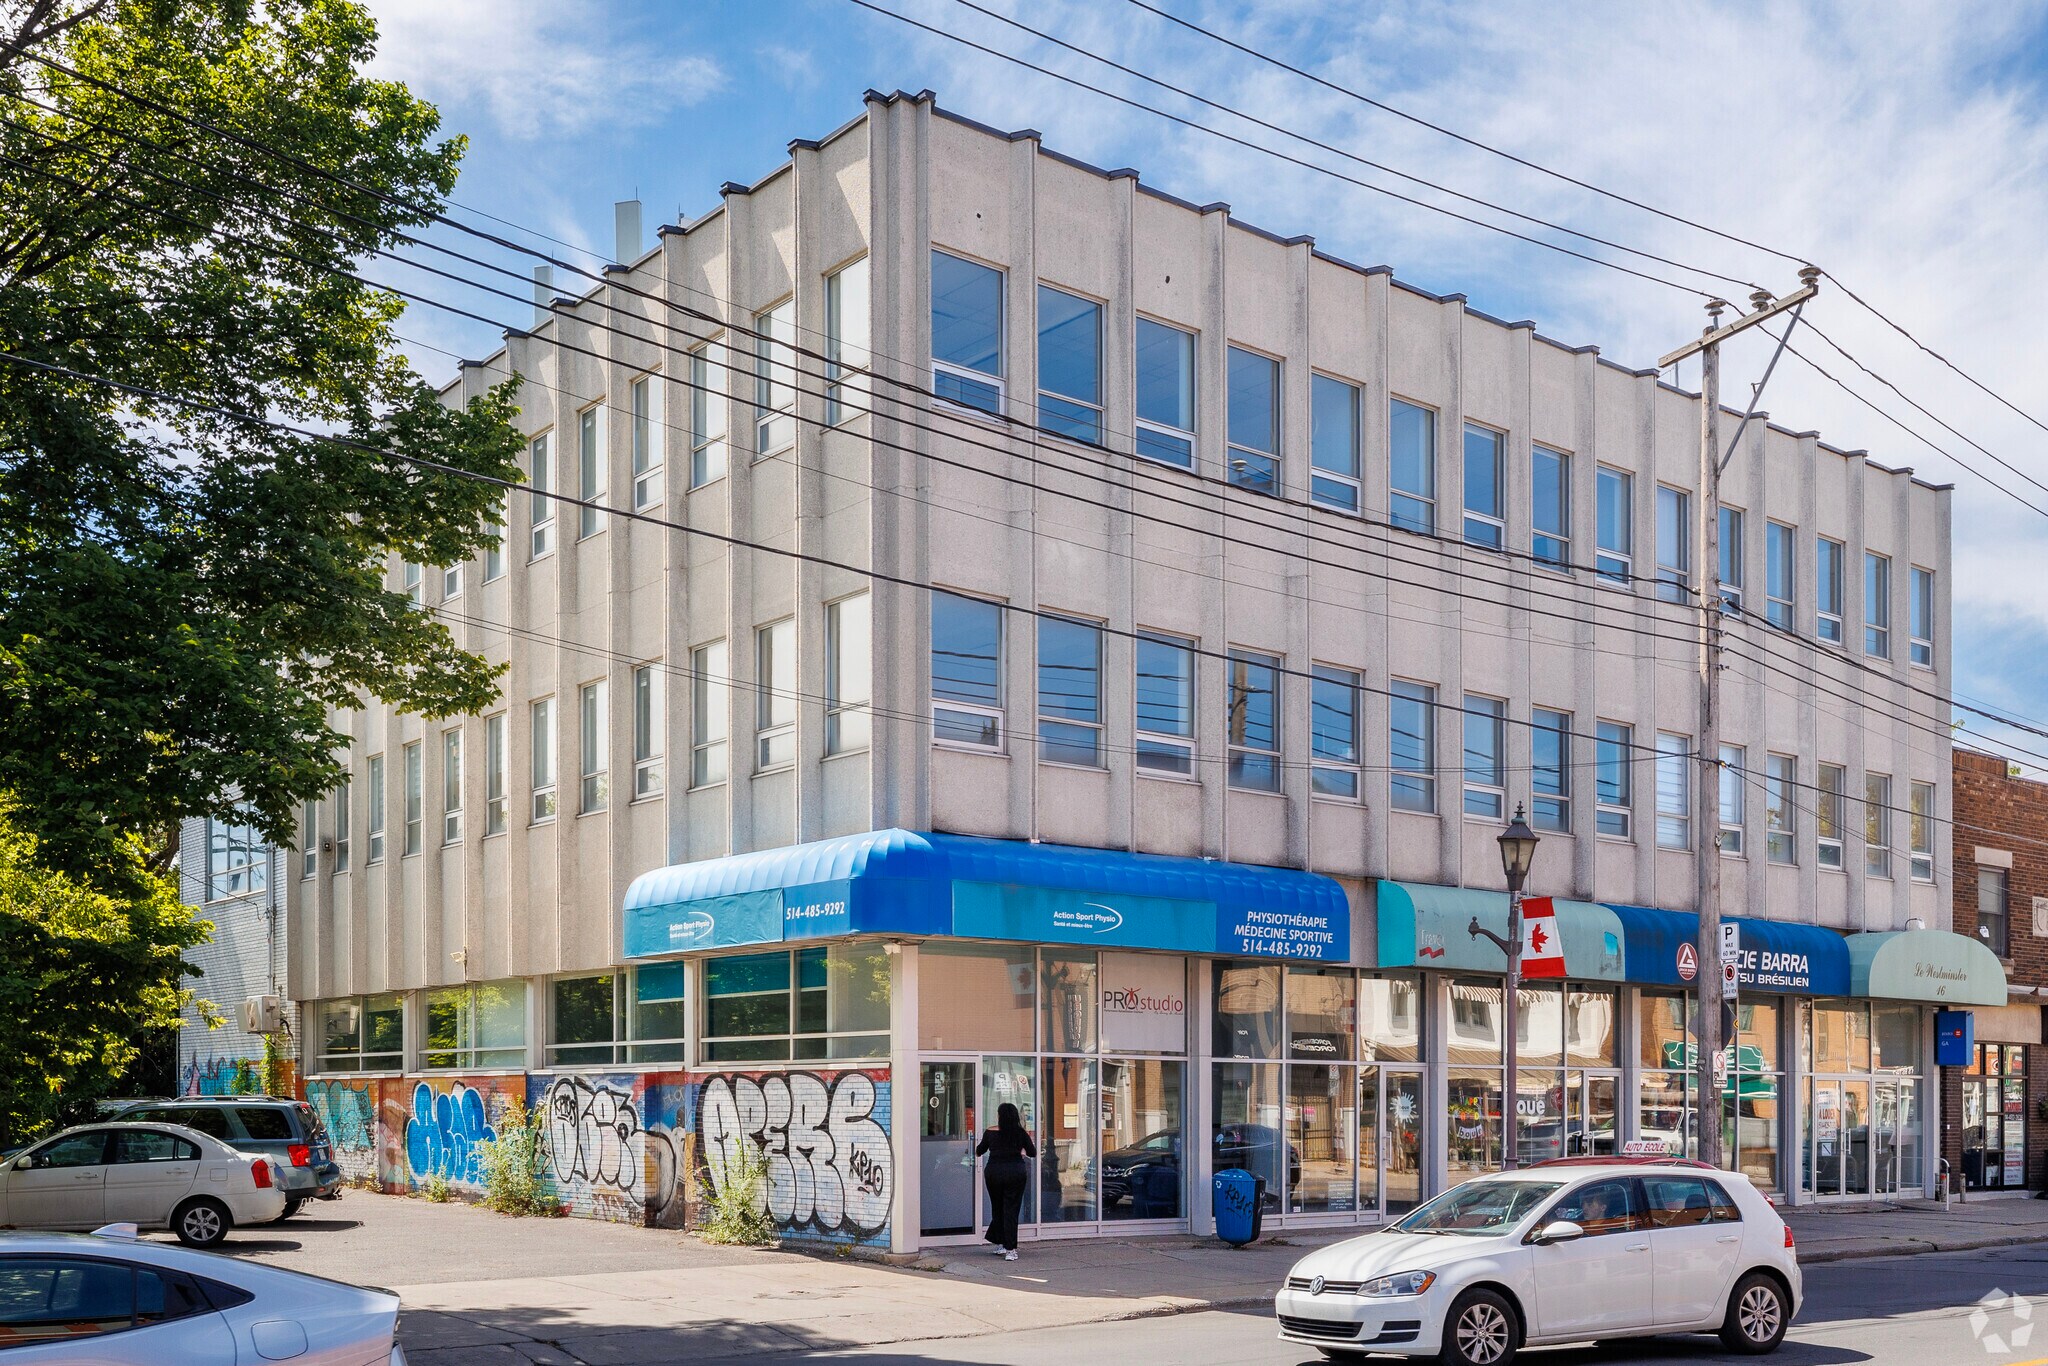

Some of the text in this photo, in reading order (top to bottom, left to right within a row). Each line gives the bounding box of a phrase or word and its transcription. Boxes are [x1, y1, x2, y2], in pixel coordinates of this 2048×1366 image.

[786, 901, 845, 920] 514-485-9292
[1053, 911, 1116, 924] Action Sport Physio
[1247, 911, 1328, 929] PHYSIOTHÉRAPIE
[1234, 923, 1334, 944] MÉDECINE SPORTIVE
[1725, 926, 1733, 940] P
[1242, 939, 1323, 958] 514-485-9292
[1737, 949, 1809, 974] CIE BARRA
[1914, 961, 1968, 981] Le Westminster
[1758, 973, 1809, 987] BRÉSILIEN
[1936, 985, 1946, 996] 16
[1516, 1098, 1546, 1115] oue
[1625, 1142, 1643, 1152] AUTO
